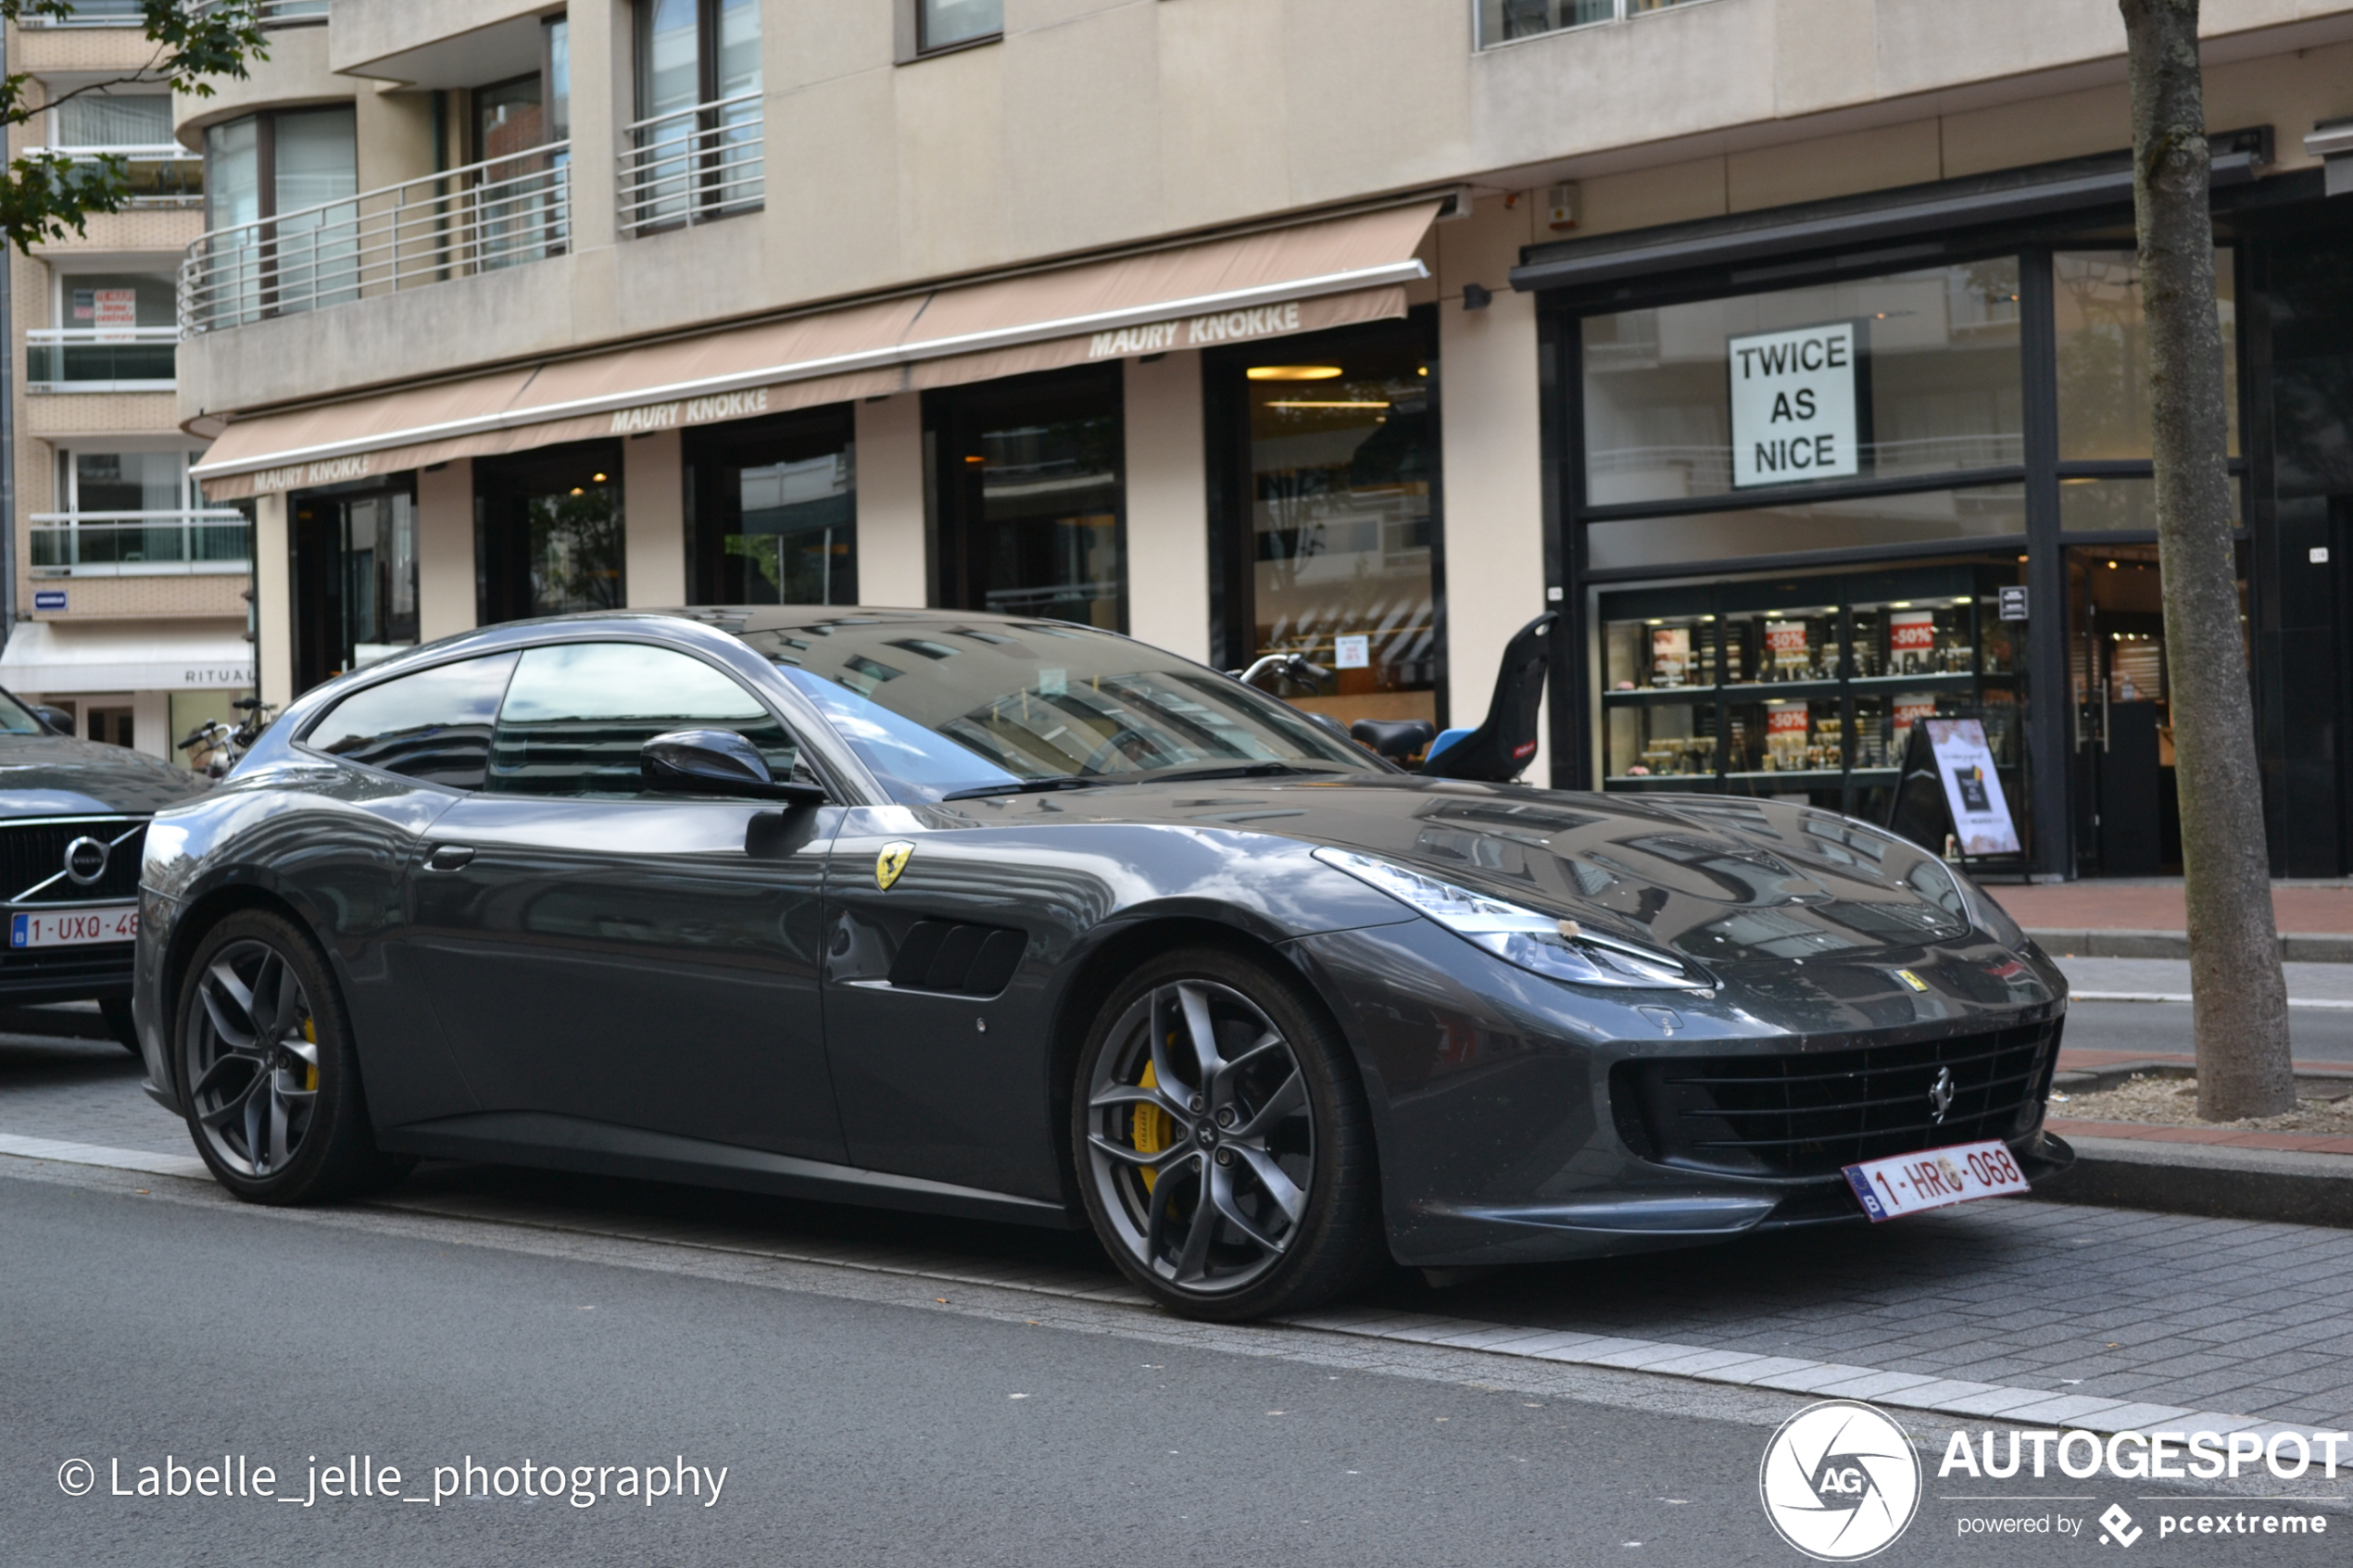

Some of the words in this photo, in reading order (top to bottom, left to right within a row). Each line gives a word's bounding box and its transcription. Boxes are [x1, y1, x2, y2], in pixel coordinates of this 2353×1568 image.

[1088, 321, 1179, 358] MAURY
[1189, 303, 1300, 344] KNOKKE
[1736, 334, 1847, 380] TWICE
[610, 401, 681, 433] MAURY
[686, 388, 769, 422] KNOKKE
[1770, 388, 1817, 423] AS
[1755, 433, 1835, 473] NICE
[254, 465, 304, 491] MAURY
[1767, 632, 1804, 648] -50%
[1892, 628, 1932, 644] -50%
[1768, 711, 1806, 728] -50%
[74, 856, 103, 864] VOLVO
[15, 932, 25, 944] B
[1863, 1195, 1881, 1212] B
